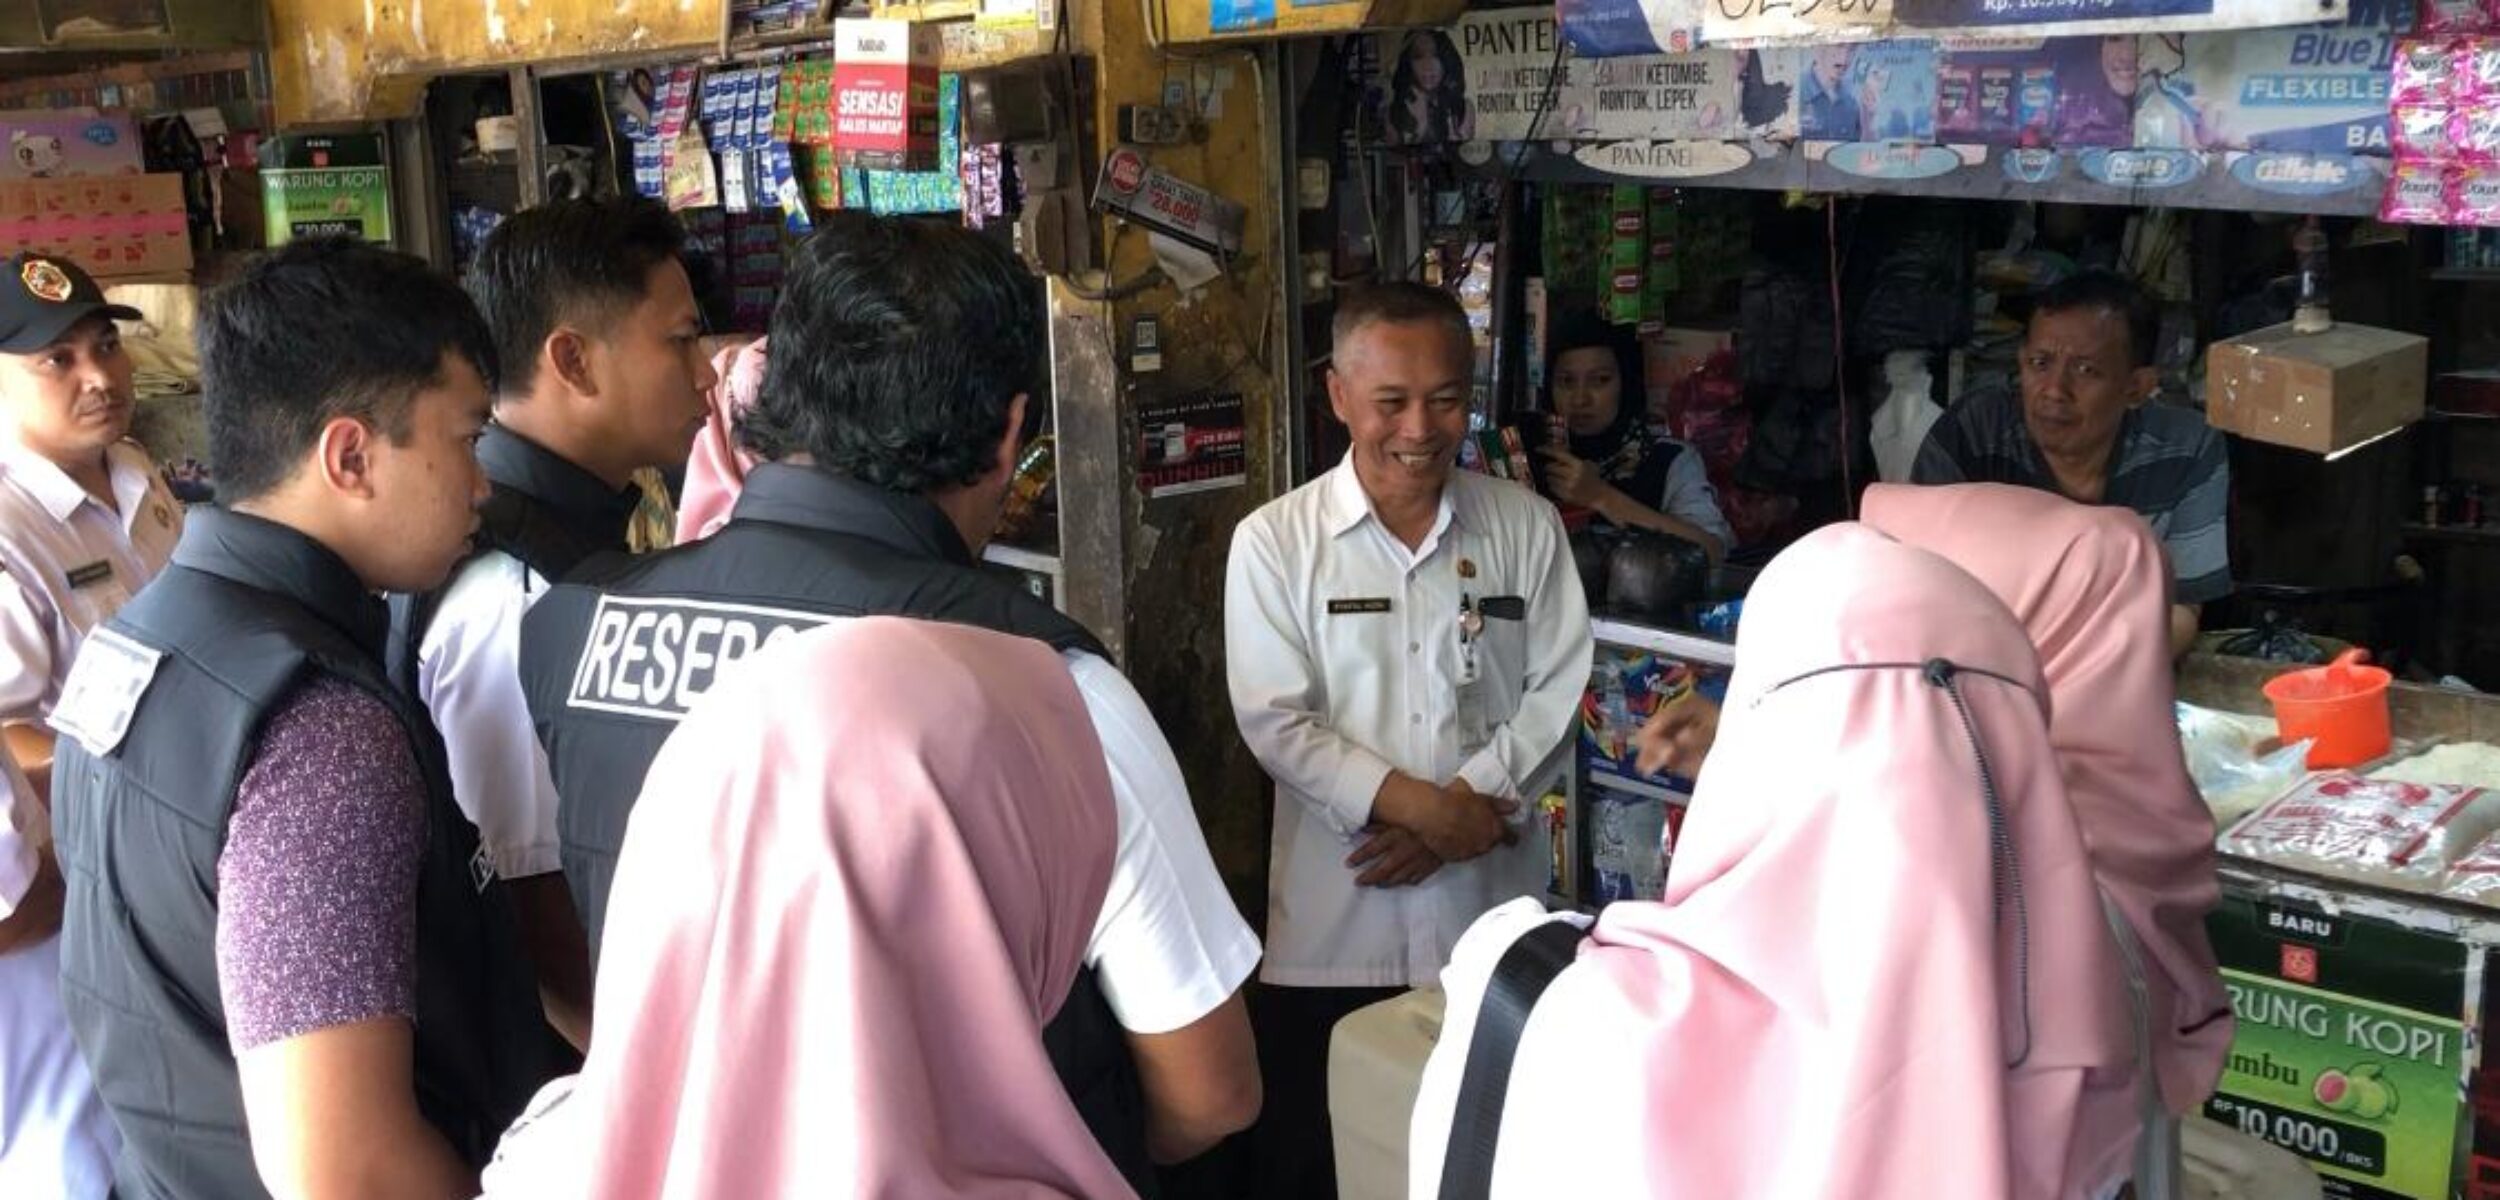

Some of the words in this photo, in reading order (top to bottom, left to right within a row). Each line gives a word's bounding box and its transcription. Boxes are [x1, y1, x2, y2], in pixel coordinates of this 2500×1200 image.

[1656, 90, 1698, 110] LEPEK
[2248, 77, 2385, 99] FLEXIBLE
[838, 88, 904, 117] SENSASI
[2346, 125, 2388, 148] BA
[266, 173, 337, 189] WARUNG
[342, 171, 379, 188] KOPI
[2255, 157, 2348, 183] Gillette
[2268, 913, 2331, 937] BARU
[2346, 1012, 2447, 1067] KOPI
[2234, 1104, 2339, 1158] 10.000
